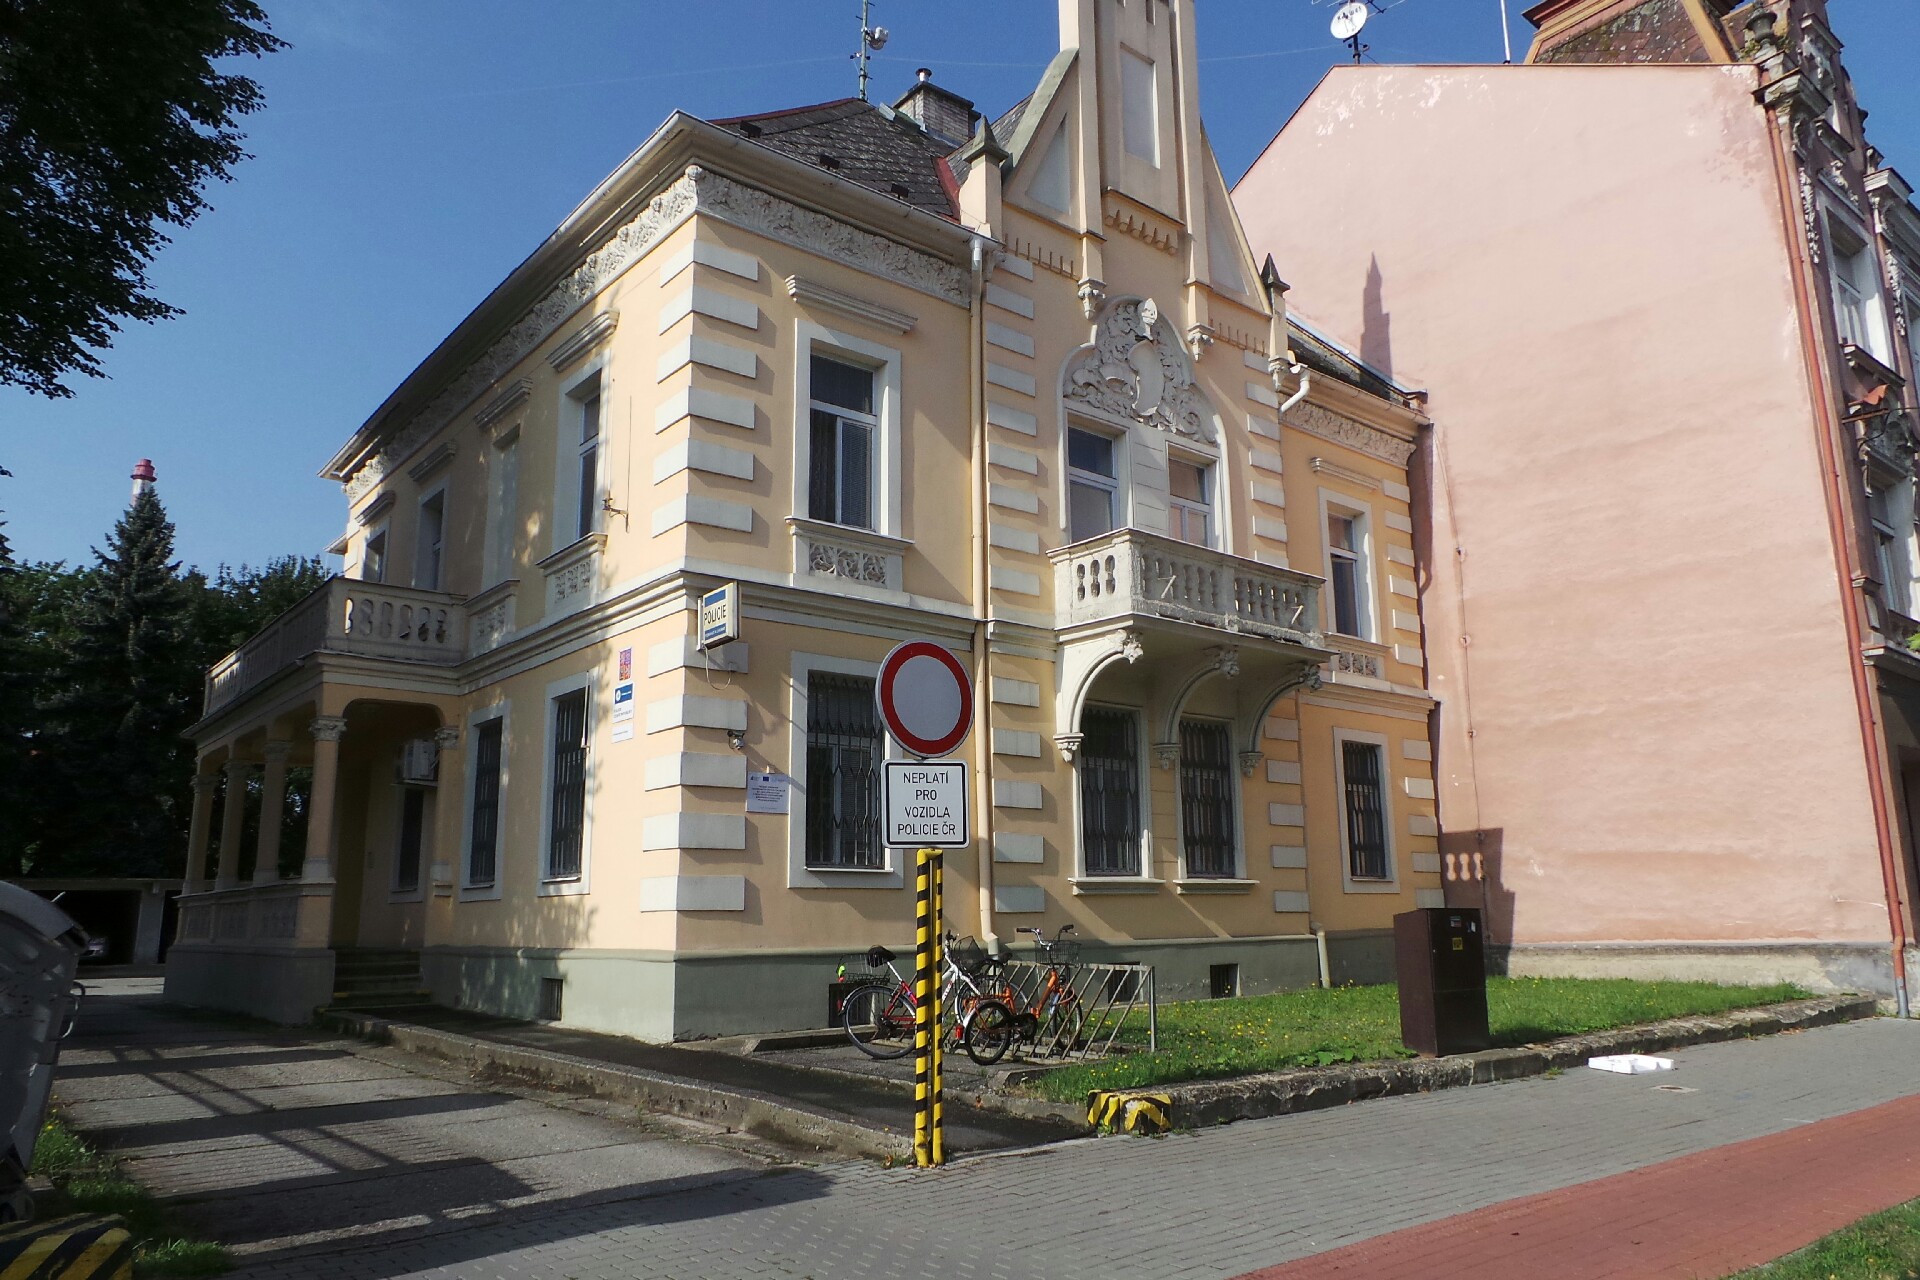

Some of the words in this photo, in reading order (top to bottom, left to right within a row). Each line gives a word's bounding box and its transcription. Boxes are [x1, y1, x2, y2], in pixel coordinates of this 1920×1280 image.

[704, 603, 726, 625] POLICIE
[903, 770, 949, 784] NEPLATÍ
[915, 789, 938, 801] PRO
[904, 806, 951, 818] VOZIDLA
[897, 823, 939, 836] POLICIE
[941, 820, 956, 836] ČR
